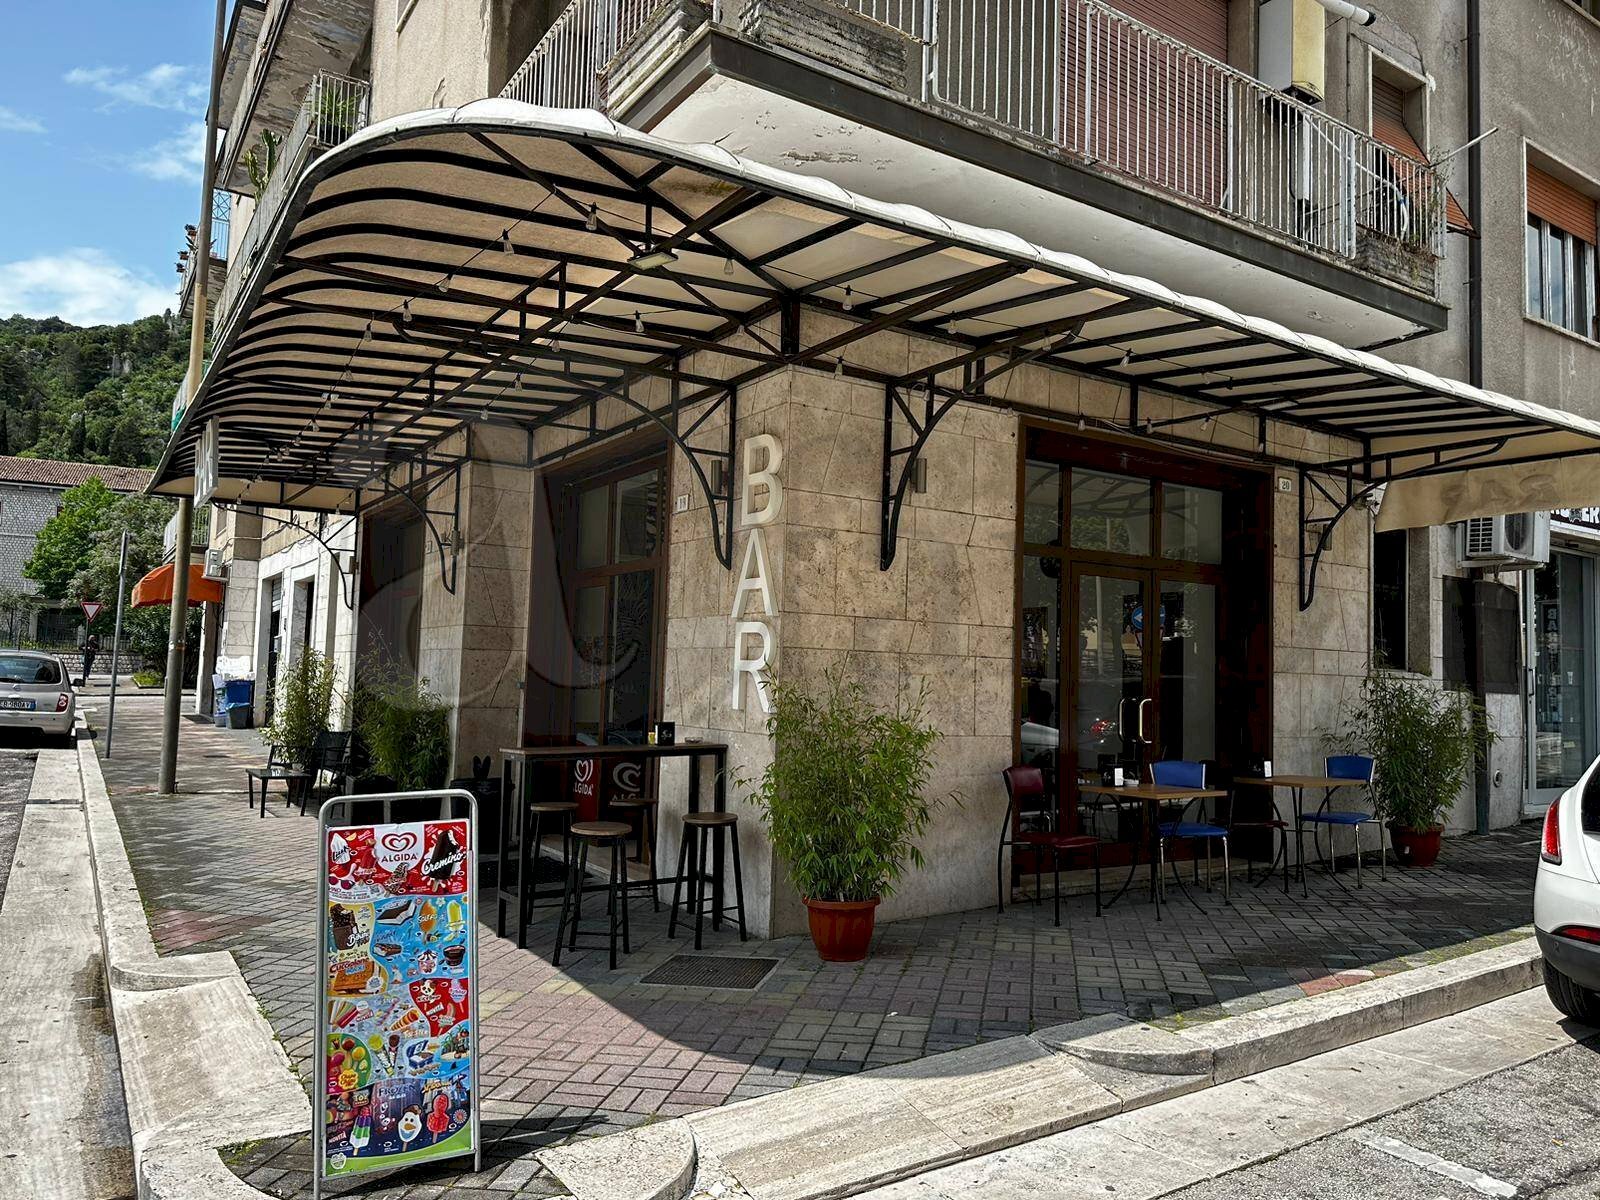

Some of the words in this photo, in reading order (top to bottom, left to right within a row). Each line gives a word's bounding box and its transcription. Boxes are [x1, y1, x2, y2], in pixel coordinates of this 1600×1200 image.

[1281, 480, 1290, 490] 20
[731, 433, 783, 713] BAR
[573, 781, 593, 796] LGIDA
[381, 853, 418, 863] ALGIDA
[421, 851, 463, 875] Cremino
[379, 1083, 416, 1096] FROZEN
